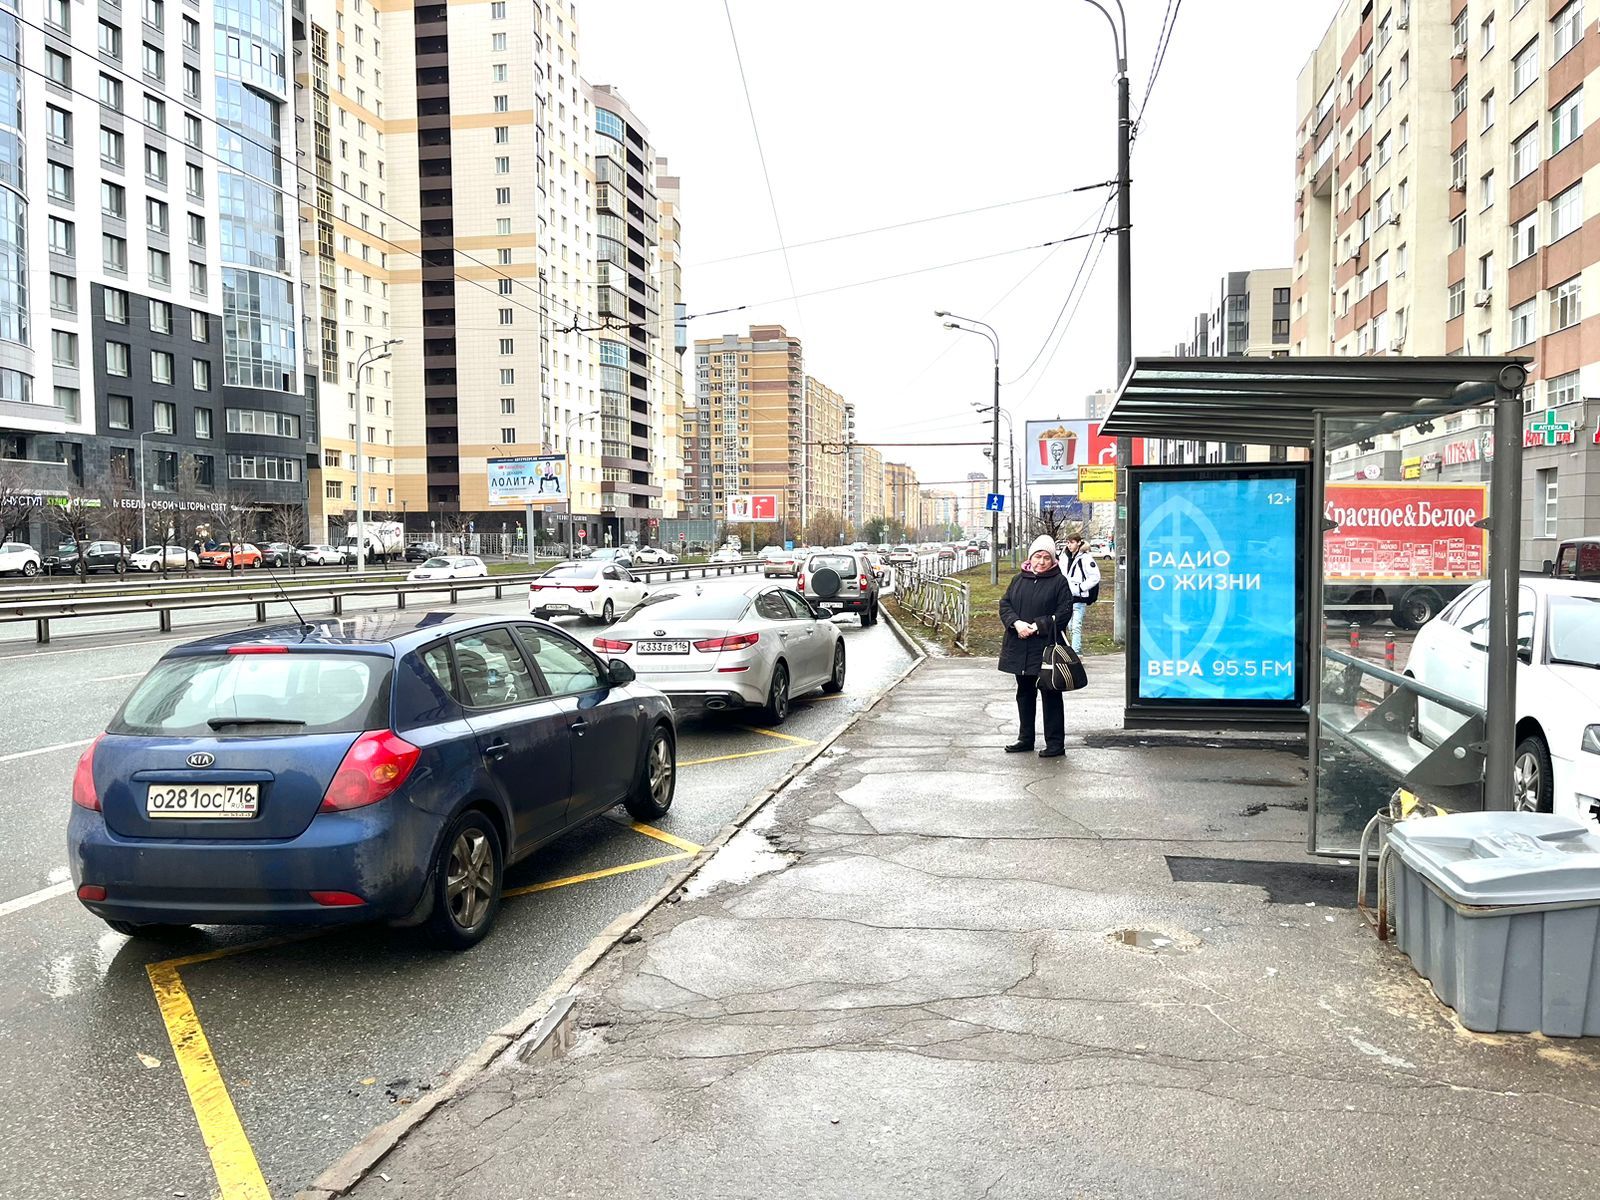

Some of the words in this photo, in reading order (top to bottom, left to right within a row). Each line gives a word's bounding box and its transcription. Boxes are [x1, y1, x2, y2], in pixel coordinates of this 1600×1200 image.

[1442, 439, 1479, 466] АПТЕКА
[491, 476, 535, 487] ЛОЛИТА
[1267, 493, 1292, 505] 12+
[210, 503, 227, 512] СВЕТ
[1148, 550, 1231, 569] РАДИО
[1148, 574, 1166, 591] О
[1174, 573, 1261, 591] ЖИЗНИ
[1147, 660, 1204, 677] ВЕРА
[1212, 660, 1258, 677] 95.5
[1261, 660, 1293, 677] FM
[190, 755, 209, 764] KIA
[227, 787, 252, 803] 716
